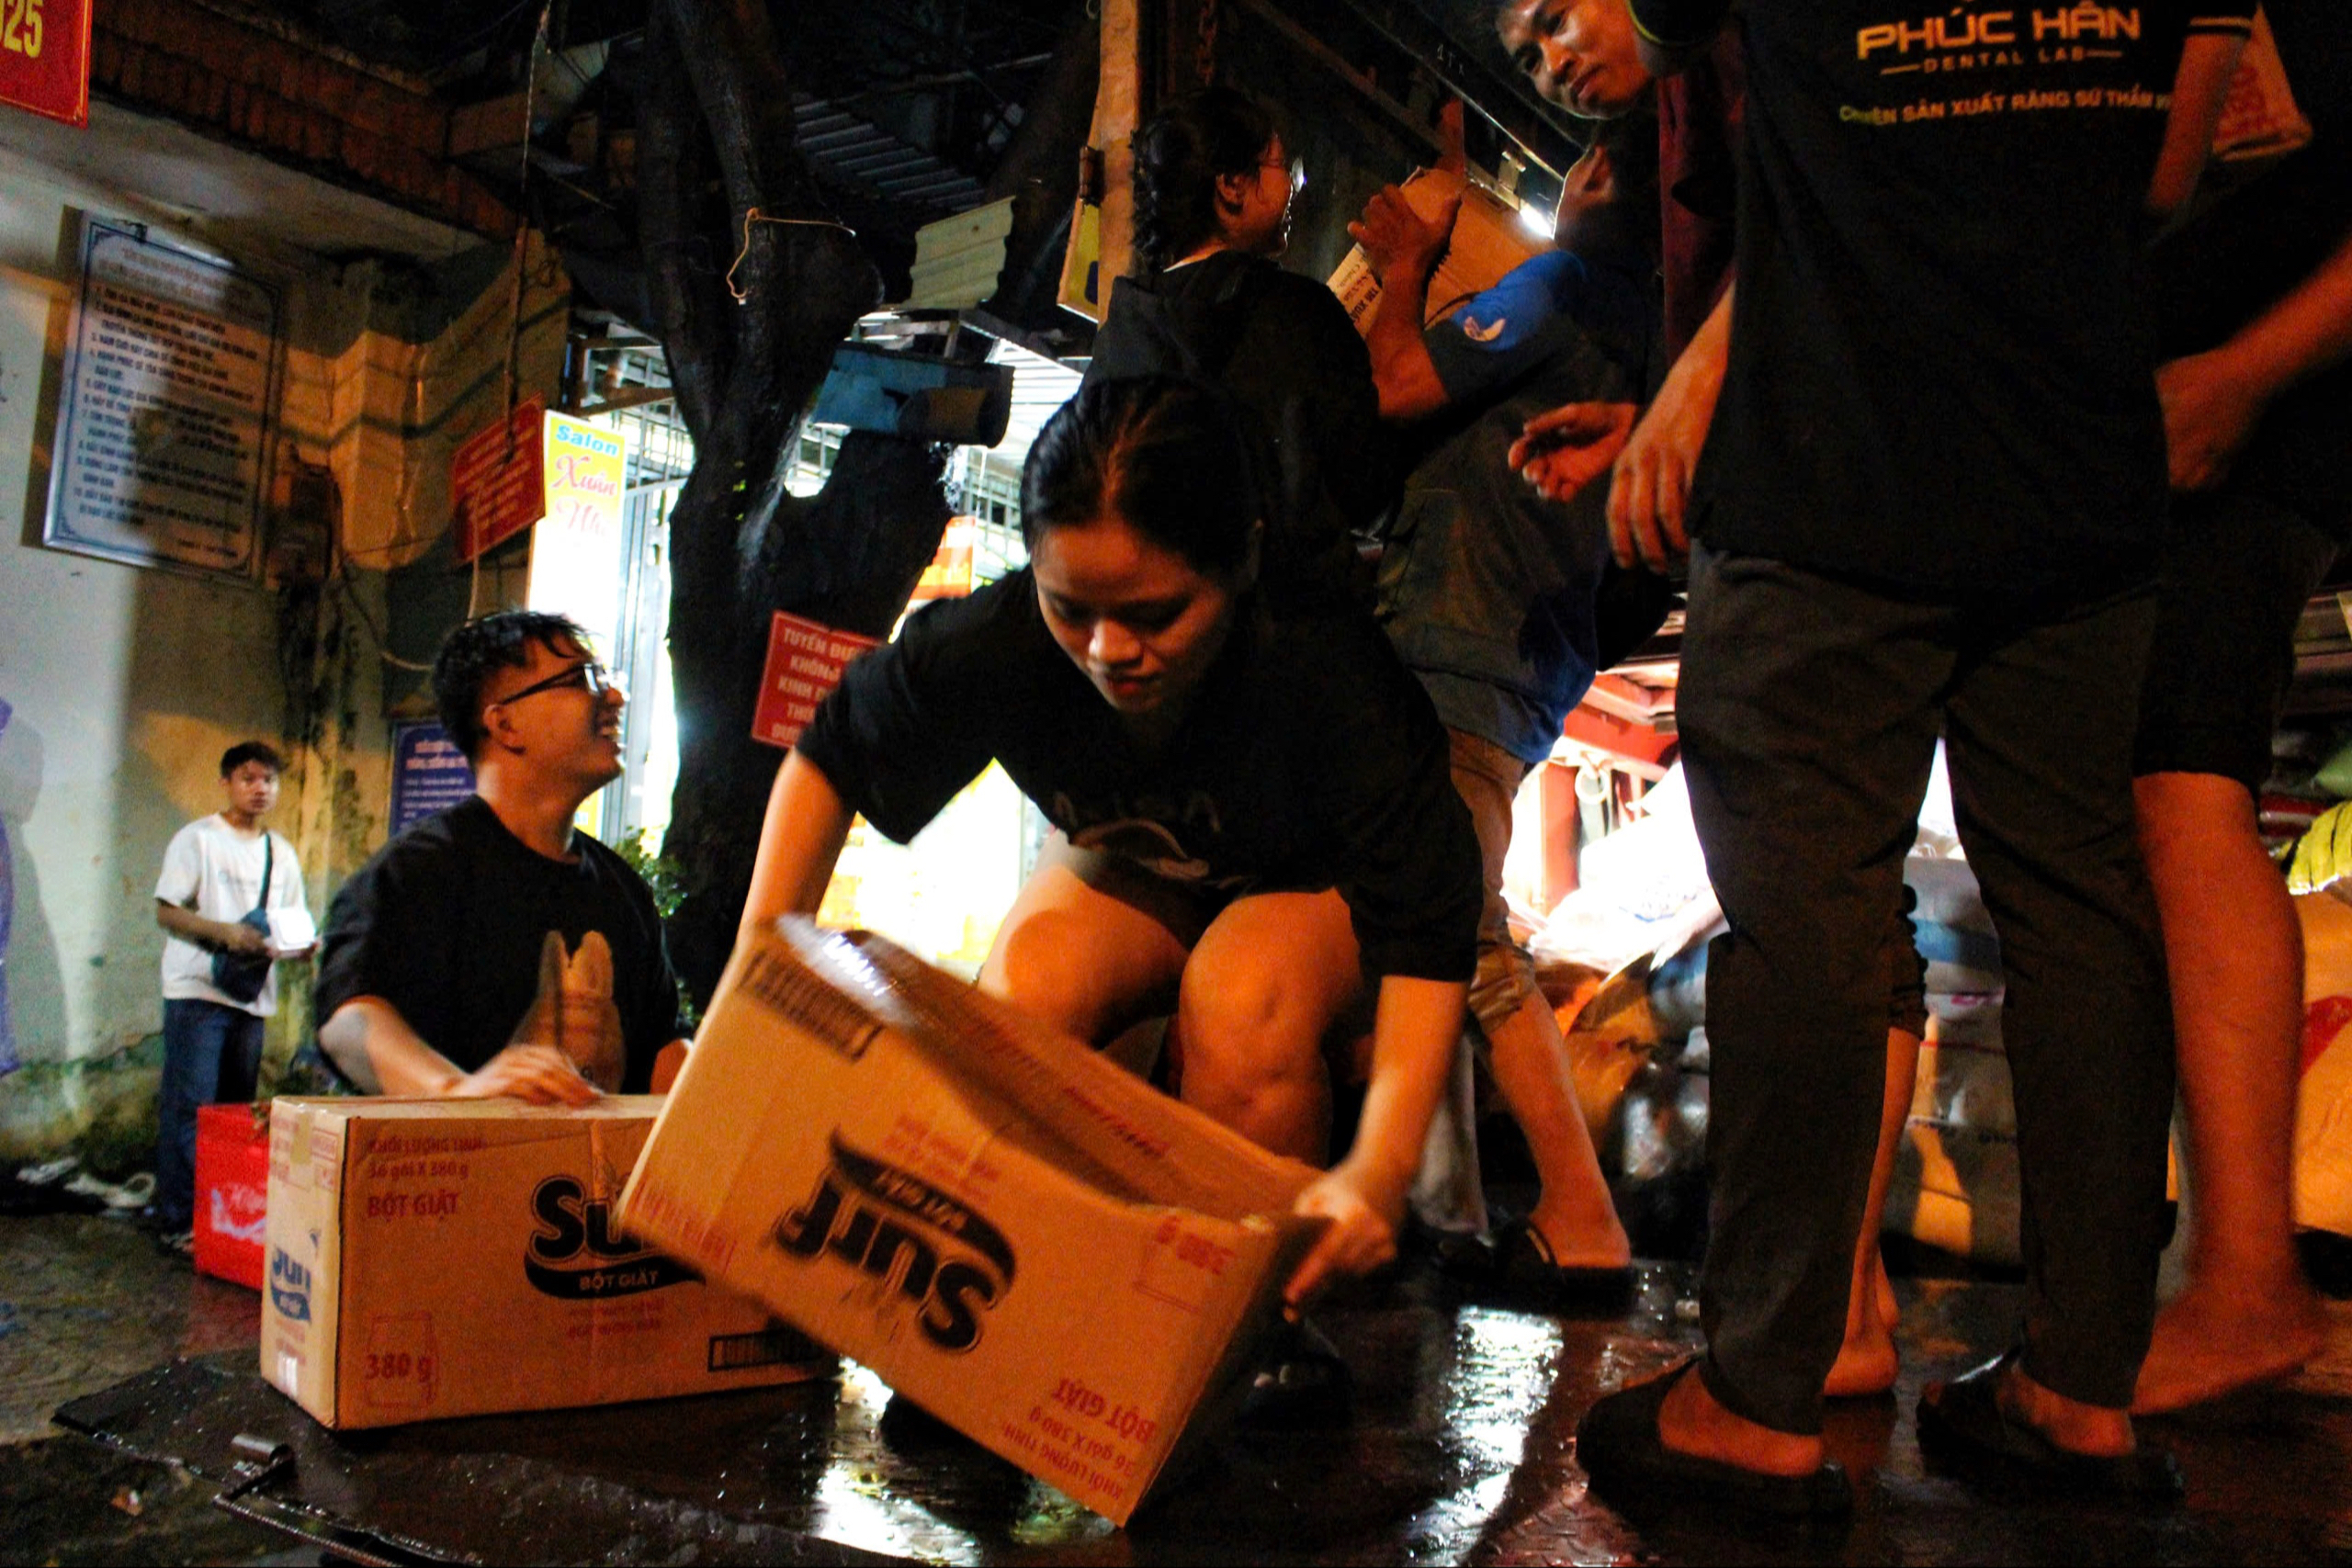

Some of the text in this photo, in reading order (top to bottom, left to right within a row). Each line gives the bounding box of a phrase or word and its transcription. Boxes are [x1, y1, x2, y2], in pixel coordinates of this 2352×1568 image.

[1857, 6, 2016, 60] PHÚC
[1924, 47, 2084, 73] DENTAL LAB
[1951, 91, 2006, 116] XUẤT
[556, 424, 618, 457] Salon
[430, 1160, 458, 1176] 380
[460, 1164, 469, 1179] g
[368, 1189, 459, 1222] BỘT GIẶT
[774, 1168, 998, 1352] Surf
[580, 1271, 614, 1293] BỘT
[366, 1352, 431, 1383] 380 g
[1052, 1378, 1156, 1443] BỘT GIẶT
[1041, 1417, 1072, 1443] 380
